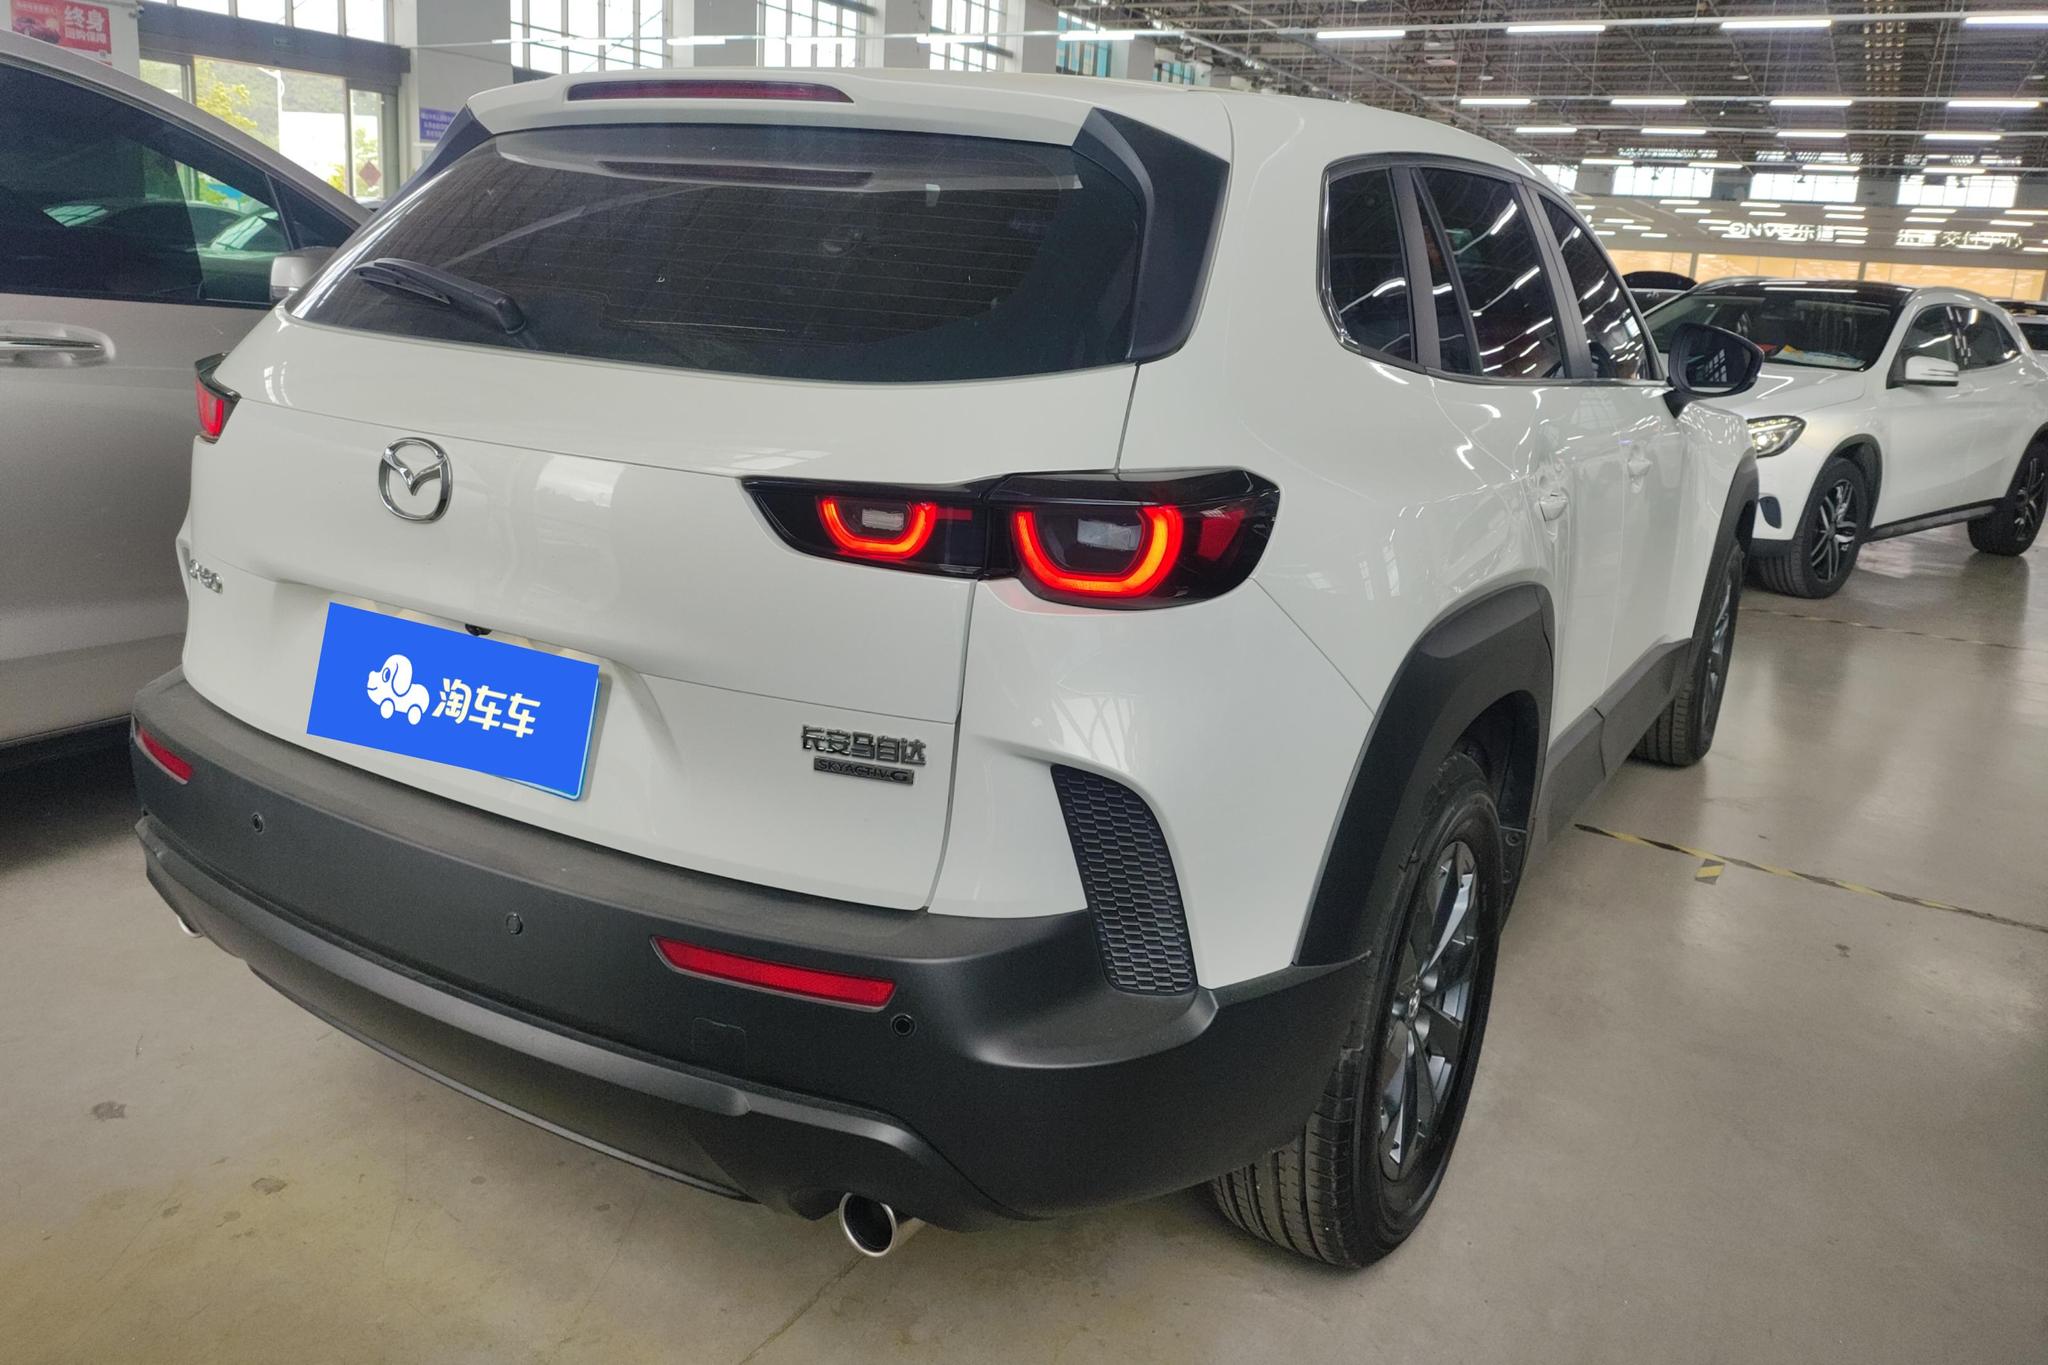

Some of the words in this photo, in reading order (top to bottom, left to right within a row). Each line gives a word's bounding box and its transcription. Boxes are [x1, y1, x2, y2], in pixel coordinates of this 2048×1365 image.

[801, 725, 927, 766] 长安马自达
